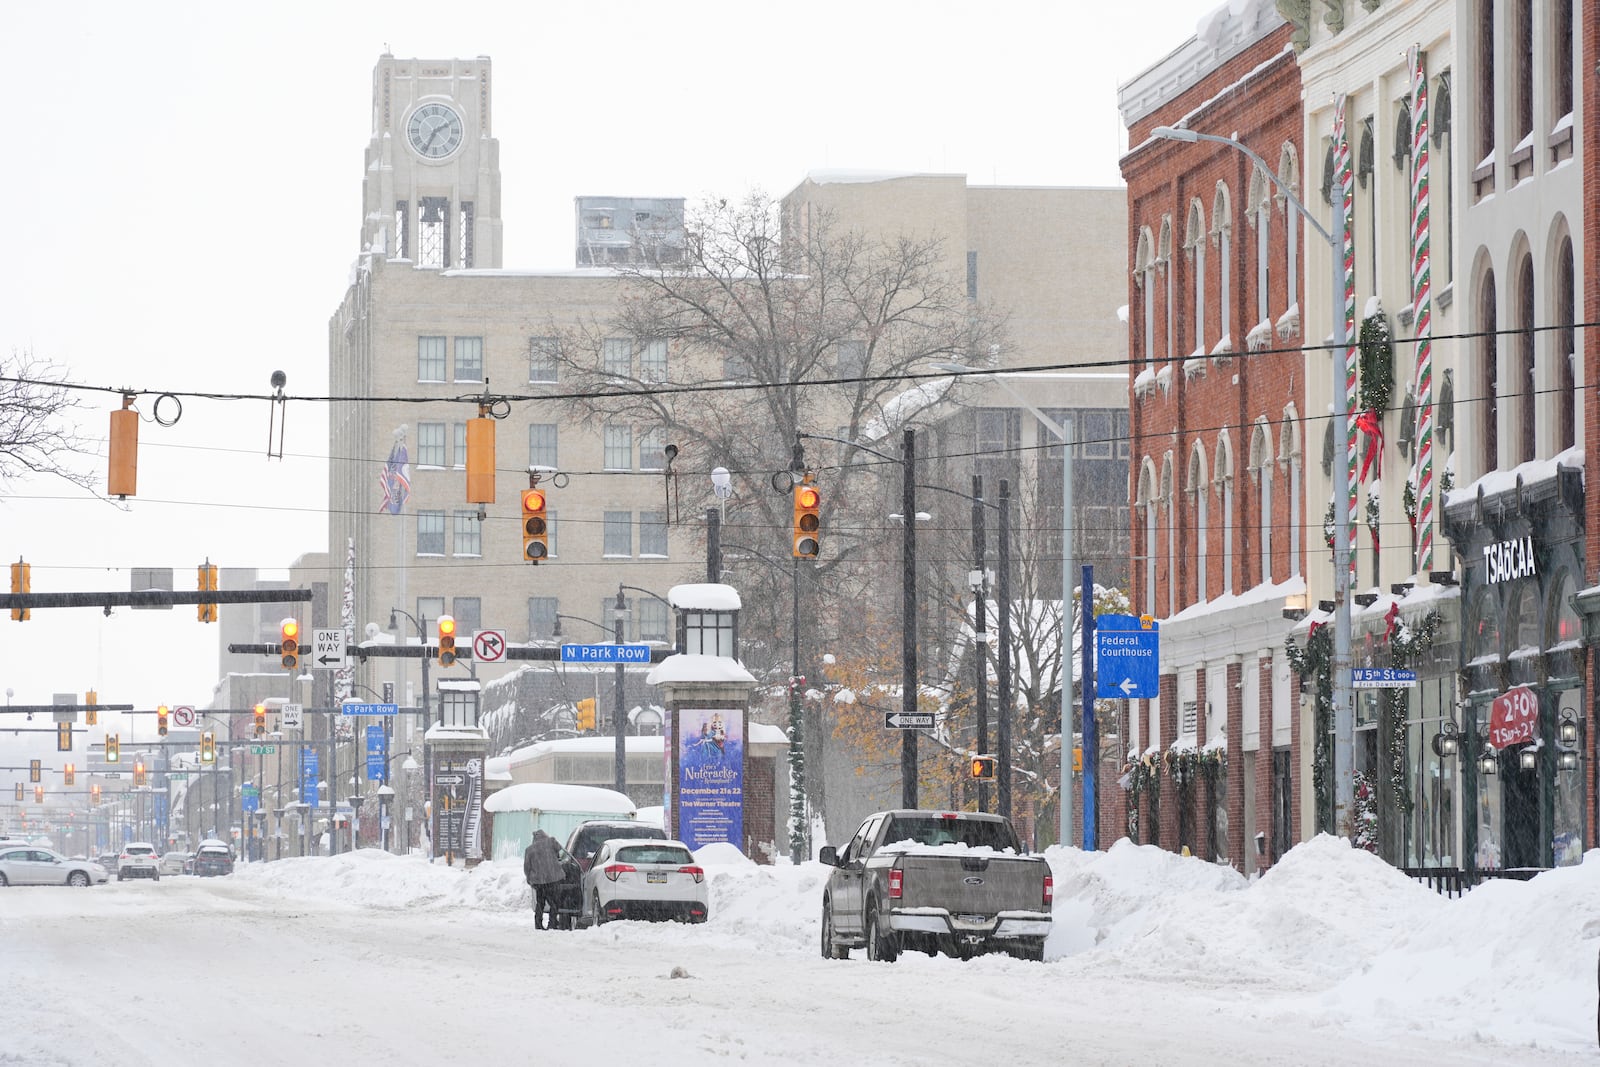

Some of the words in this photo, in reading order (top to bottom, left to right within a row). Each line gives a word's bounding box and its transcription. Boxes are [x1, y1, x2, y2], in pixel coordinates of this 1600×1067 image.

[318, 632, 340, 641] ONE
[1101, 636, 1139, 645] Federal
[317, 643, 340, 652] WAY
[566, 647, 576, 658] N
[582, 647, 612, 658] Park
[617, 647, 645, 658] Row
[1101, 648, 1152, 657] Courthouse
[1353, 670, 1363, 680] W
[1365, 670, 1380, 680] 5th
[1383, 669, 1396, 680] St
[346, 705, 352, 713] S
[354, 705, 374, 713] Park
[376, 705, 395, 713] Row
[685, 766, 738, 781] Nutcracker
